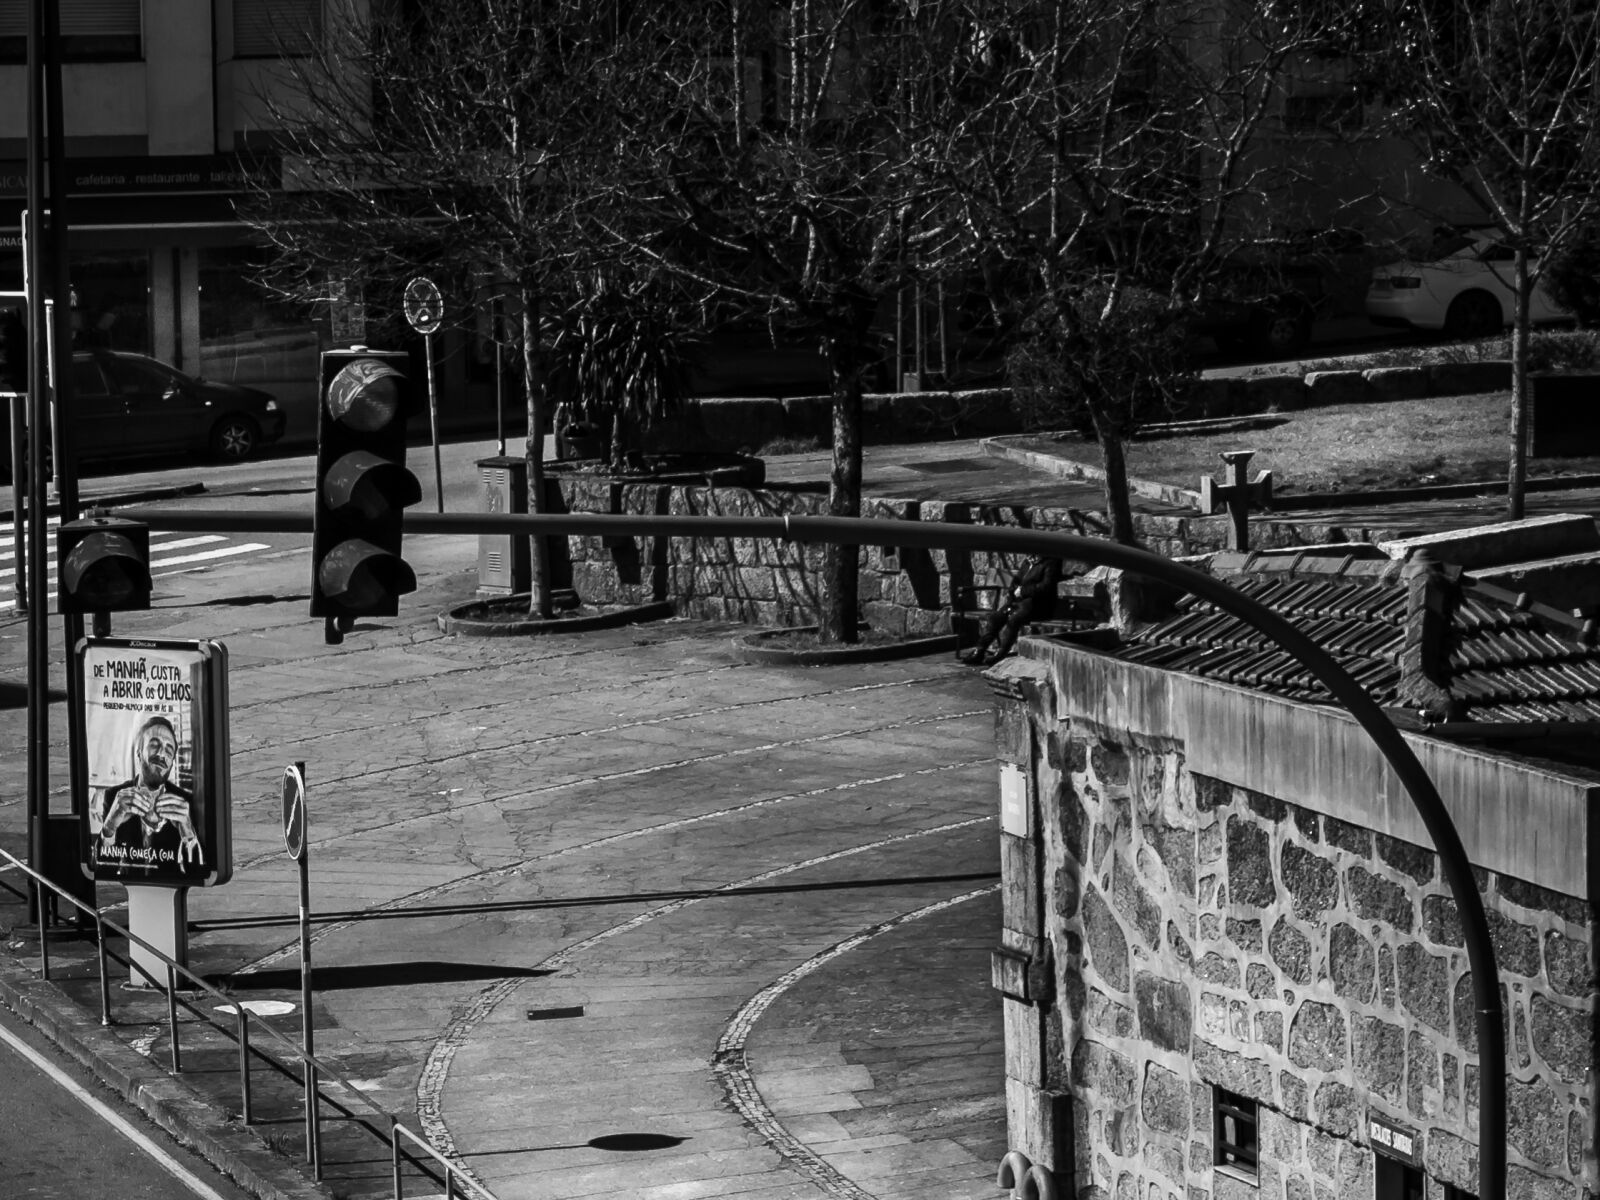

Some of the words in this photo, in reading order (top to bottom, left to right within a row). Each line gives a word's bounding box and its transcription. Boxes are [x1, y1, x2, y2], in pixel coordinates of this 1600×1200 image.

[135, 172, 200, 184] restaurante
[93, 664, 105, 678] DE
[106, 657, 149, 683] MANHÃ,
[151, 665, 181, 681] CUSTA
[103, 684, 109, 697] A
[112, 681, 143, 699] ABRIR
[145, 687, 155, 700] OS
[157, 682, 194, 702] OLHOS.
[100, 842, 127, 858] MANHÃ
[129, 846, 157, 863] COMEÇA
[159, 848, 175, 862] COM
